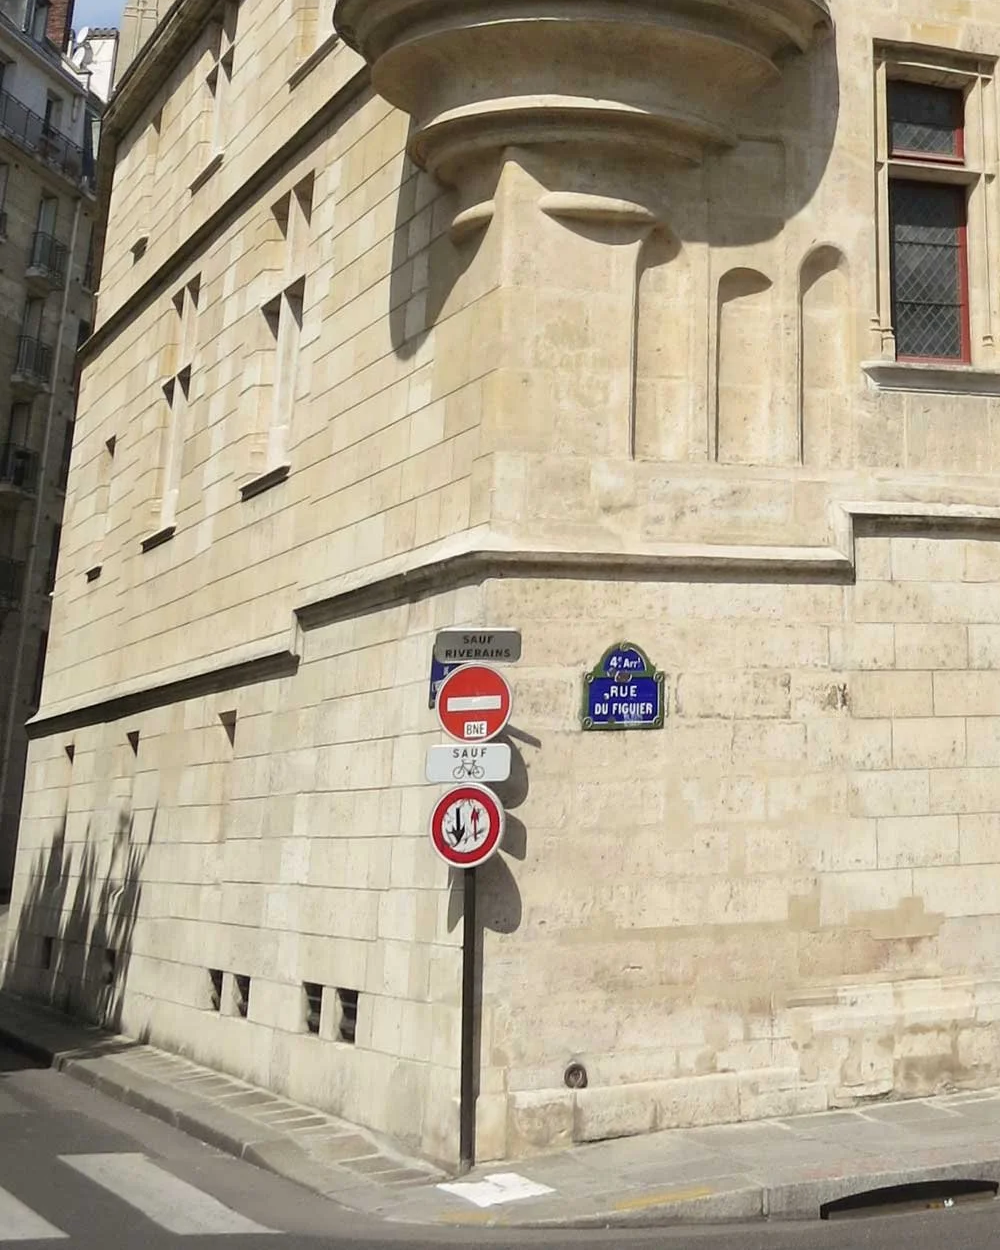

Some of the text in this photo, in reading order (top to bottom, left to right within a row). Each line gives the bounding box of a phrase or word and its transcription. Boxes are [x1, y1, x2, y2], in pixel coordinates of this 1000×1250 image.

[463, 635, 495, 644] SAUF
[445, 648, 511, 658] RIVERAINS
[610, 685, 637, 697] RUE
[594, 702, 653, 715] DU FIGUIER
[466, 723, 485, 735] BNE
[452, 747, 487, 758] SAUF
